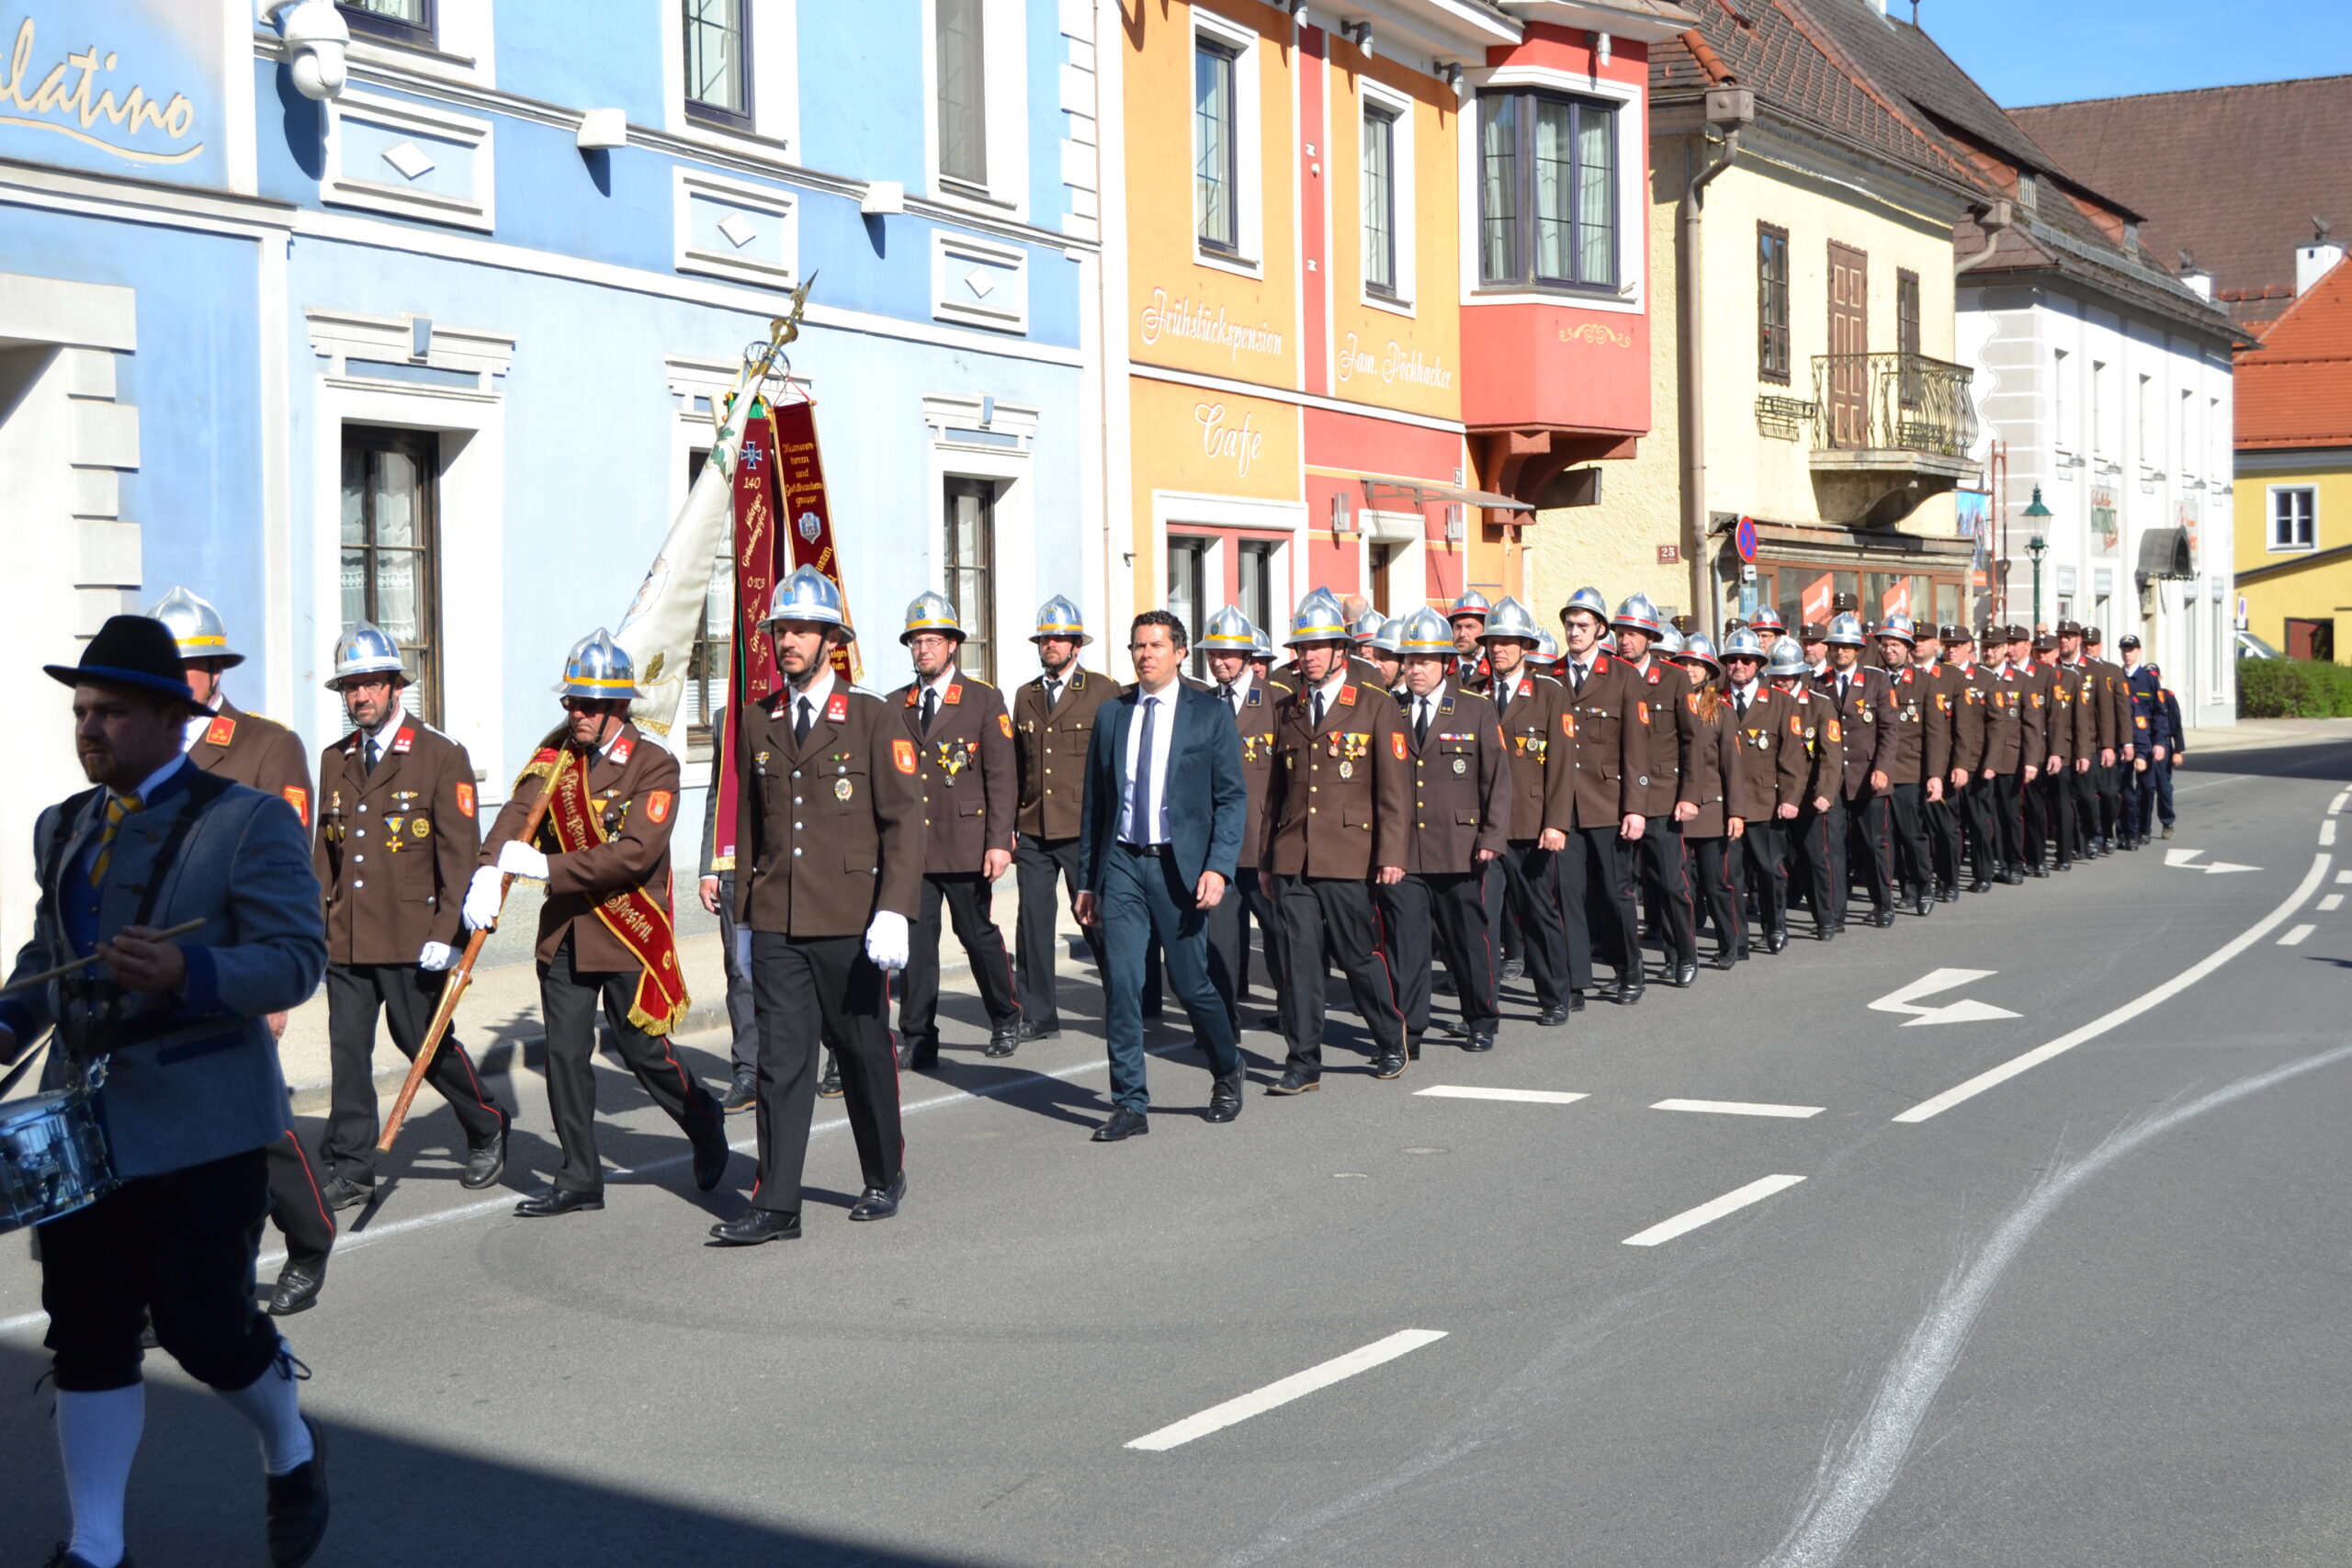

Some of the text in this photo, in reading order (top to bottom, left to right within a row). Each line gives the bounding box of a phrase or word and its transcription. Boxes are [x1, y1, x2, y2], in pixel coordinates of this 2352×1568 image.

[1140, 287, 1283, 362] Frühstückspension
[1337, 332, 1452, 390] Fam. Pöchhacker
[1194, 403, 1261, 478] Cafe
[742, 476, 762, 490] 140
[795, 468, 809, 479] und
[744, 491, 763, 531] jähriges
[741, 505, 767, 569] Gründungsfest
[1660, 547, 1676, 558] 25
